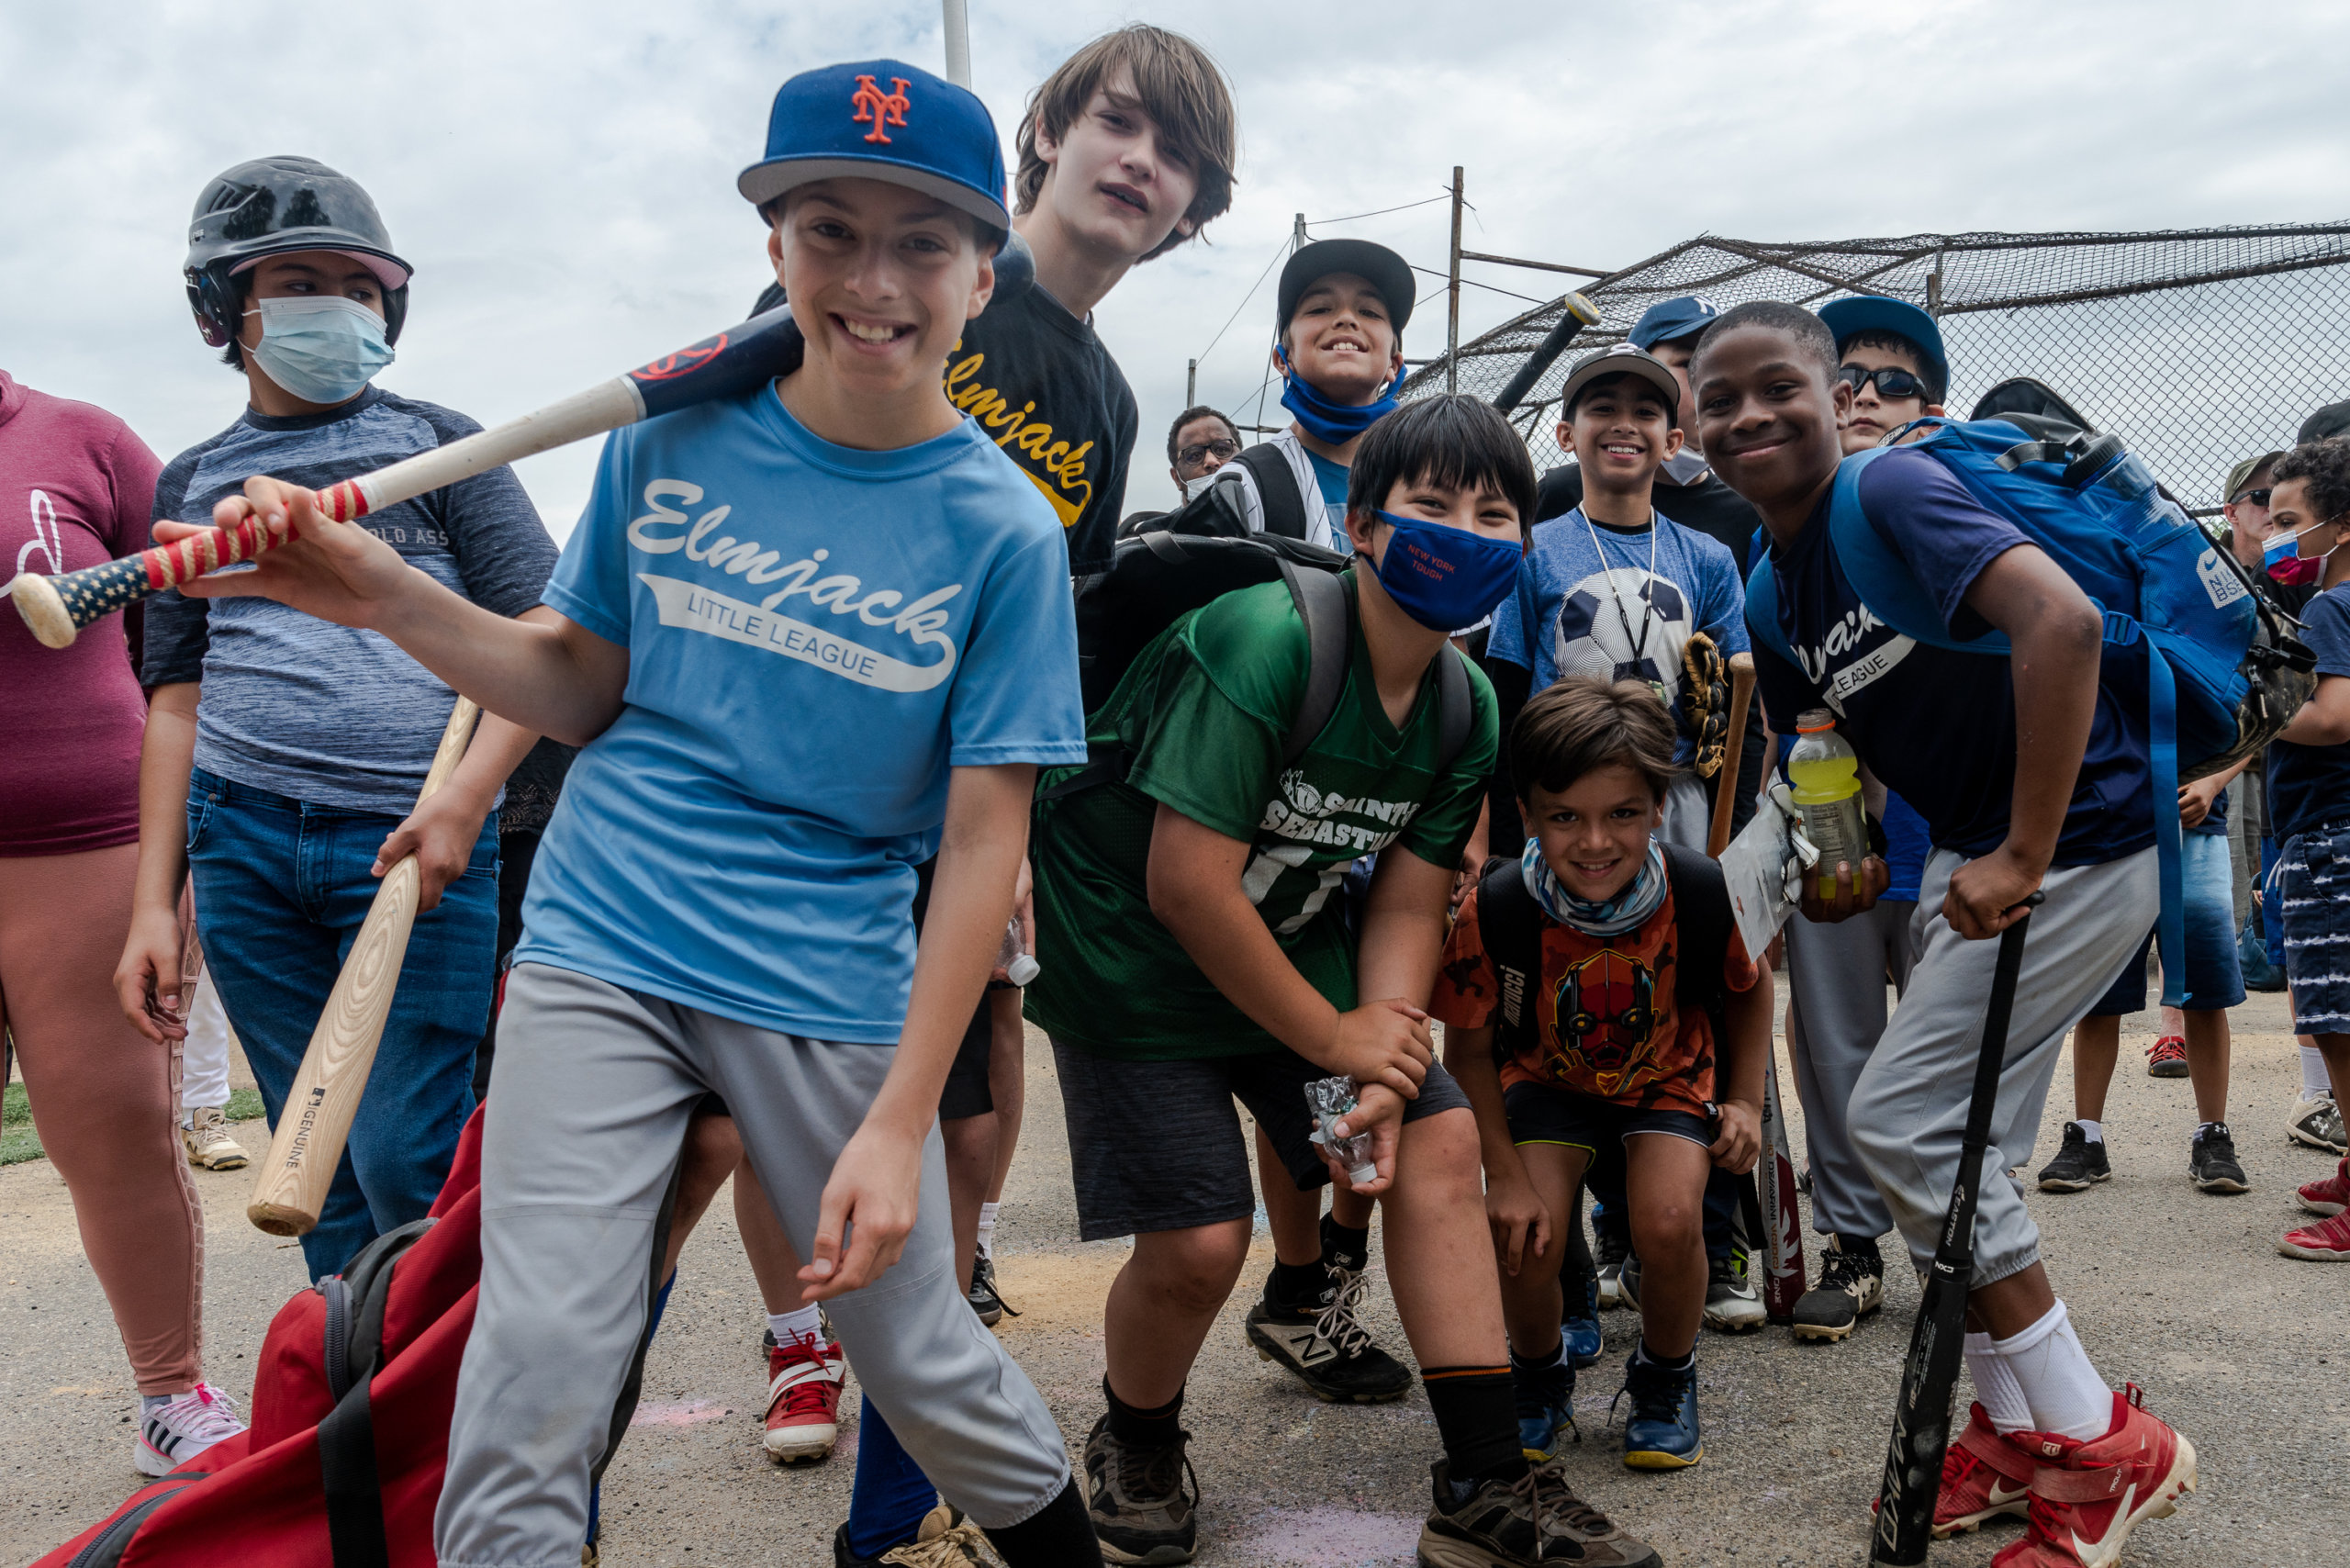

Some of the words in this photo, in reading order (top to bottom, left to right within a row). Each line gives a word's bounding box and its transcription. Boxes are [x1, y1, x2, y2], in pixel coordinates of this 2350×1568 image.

[627, 478, 963, 645] Elmjack
[1408, 543, 1430, 561] NEW
[1432, 556, 1456, 574] YORK
[1413, 559, 1443, 581] TOUGH
[688, 592, 764, 637] LITTLE
[769, 623, 878, 678] LEAGUE
[1500, 964, 1526, 1027] marucci
[286, 1109, 316, 1168] GENUINE
[1945, 1196, 1962, 1248] EASTON
[1934, 1260, 1954, 1273] CXN
[1881, 1410, 1908, 1553] MAKO
[2109, 1468, 2122, 1493] TROUT
